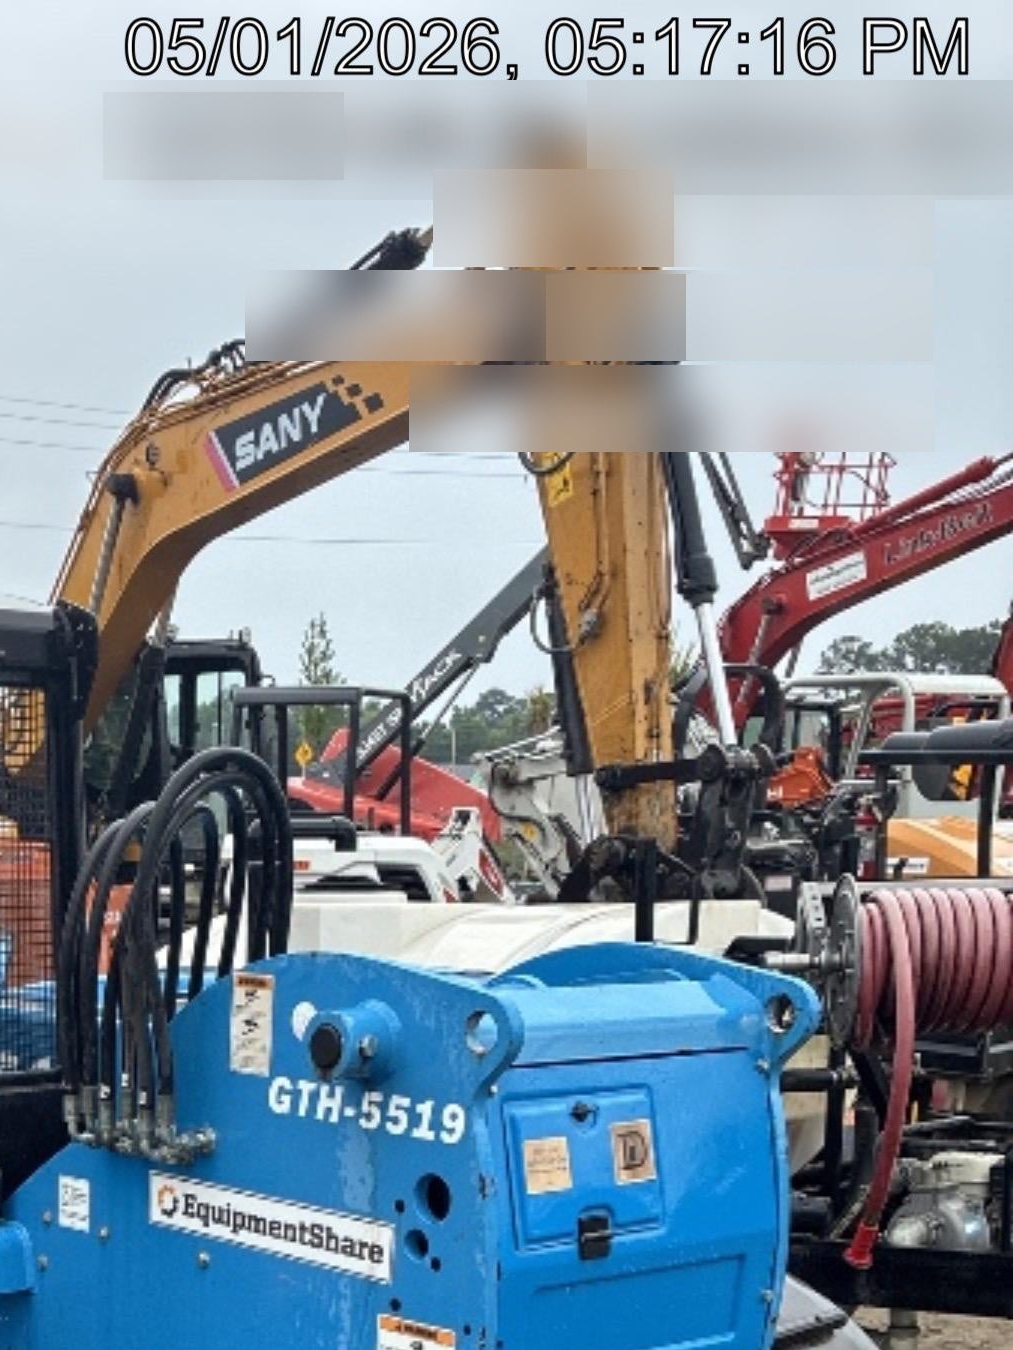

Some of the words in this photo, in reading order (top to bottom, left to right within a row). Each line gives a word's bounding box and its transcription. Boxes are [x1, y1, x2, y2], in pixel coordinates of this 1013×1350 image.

[235, 393, 327, 471] SANY
[268, 1077, 466, 1144] GTH-5519
[181, 1193, 384, 1263] EquipmentShare
